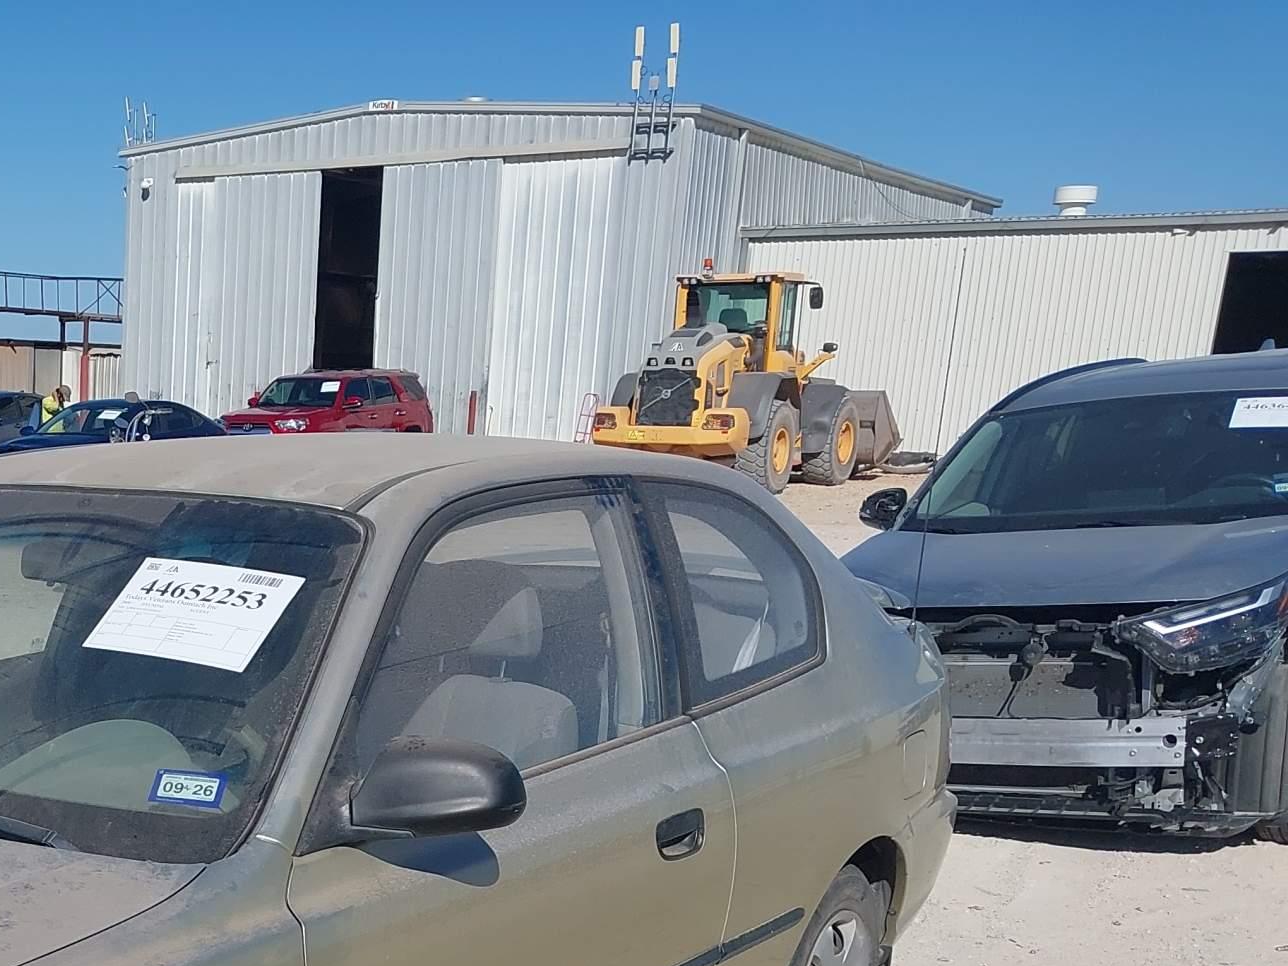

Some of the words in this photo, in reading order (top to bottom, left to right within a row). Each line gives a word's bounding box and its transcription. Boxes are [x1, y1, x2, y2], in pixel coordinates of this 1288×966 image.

[141, 578, 268, 610] 44652253
[163, 781, 184, 794] 09
[192, 784, 214, 797] 26
